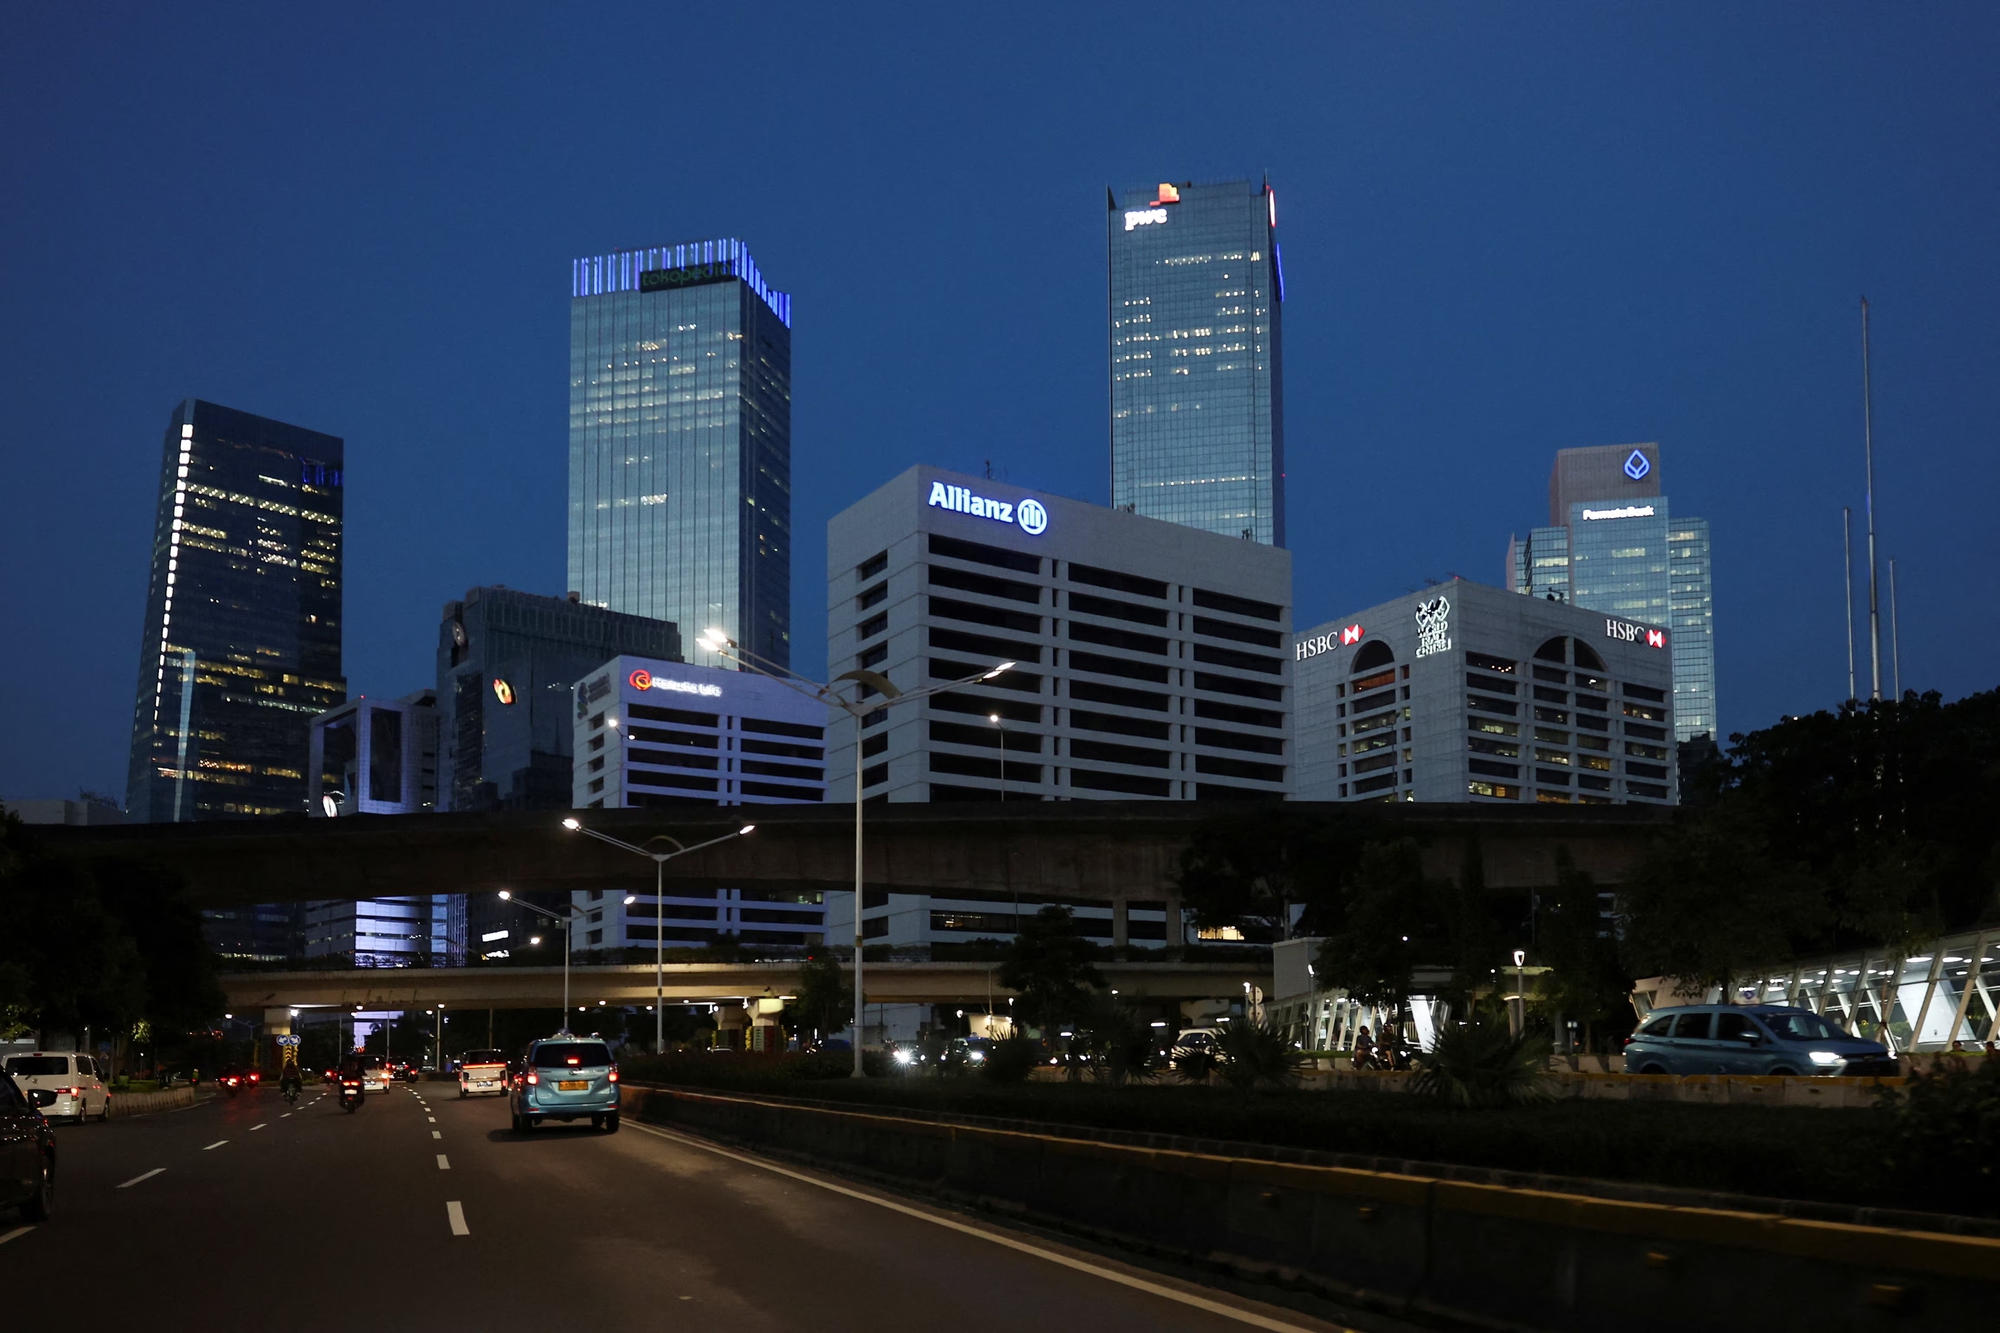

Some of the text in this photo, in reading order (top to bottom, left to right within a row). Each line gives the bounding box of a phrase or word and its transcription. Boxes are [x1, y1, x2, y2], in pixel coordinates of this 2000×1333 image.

[1125, 208, 1168, 231] pwc
[642, 262, 732, 287] tokopedia
[928, 481, 1014, 523] Allianz
[1606, 618, 1645, 643] HSBC
[1295, 631, 1339, 662] HSBC
